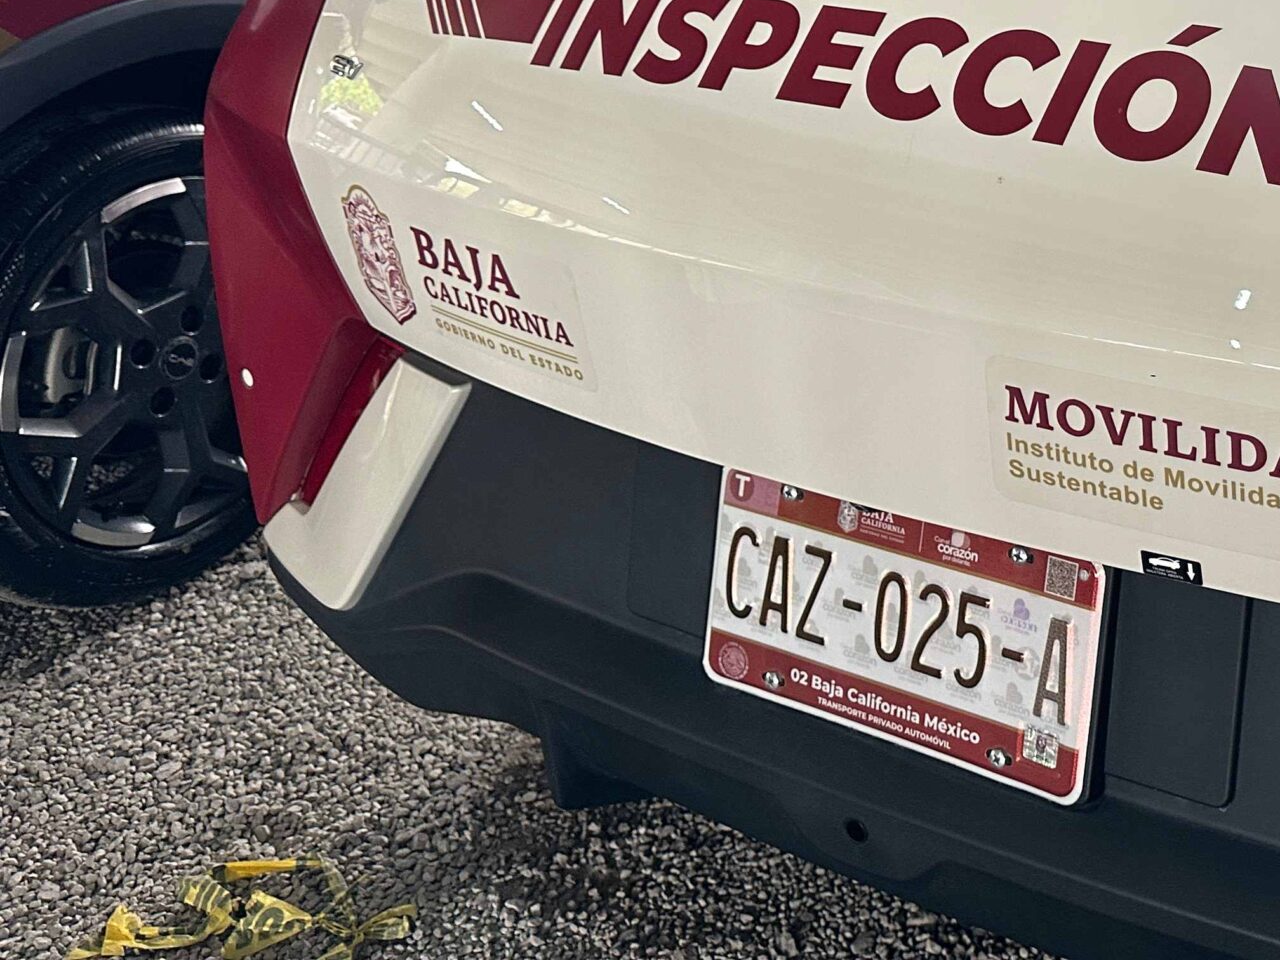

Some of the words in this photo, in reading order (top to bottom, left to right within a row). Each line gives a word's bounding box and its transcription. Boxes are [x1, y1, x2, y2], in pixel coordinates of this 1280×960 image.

[410, 226, 520, 300] BAJA
[424, 276, 574, 347] CALIFORNIA
[435, 318, 495, 350] GOBIERNO
[500, 343, 525, 361] DEL
[530, 355, 584, 381] ESTADO
[735, 473, 751, 497] T
[1006, 432, 1114, 473] Instituto
[1123, 459, 1154, 483] de
[1009, 458, 1164, 511] Sustentable
[937, 543, 979, 563] corazón
[726, 526, 1071, 727] CAZ-025-A
[790, 668, 808, 686] 02
[811, 675, 844, 699] Baja
[847, 688, 920, 725] California
[924, 712, 981, 745] México
[817, 696, 867, 721] TRANSPORTE
[868, 714, 904, 733] PRIVADO
[904, 727, 951, 750] AUTOMÓVIL
